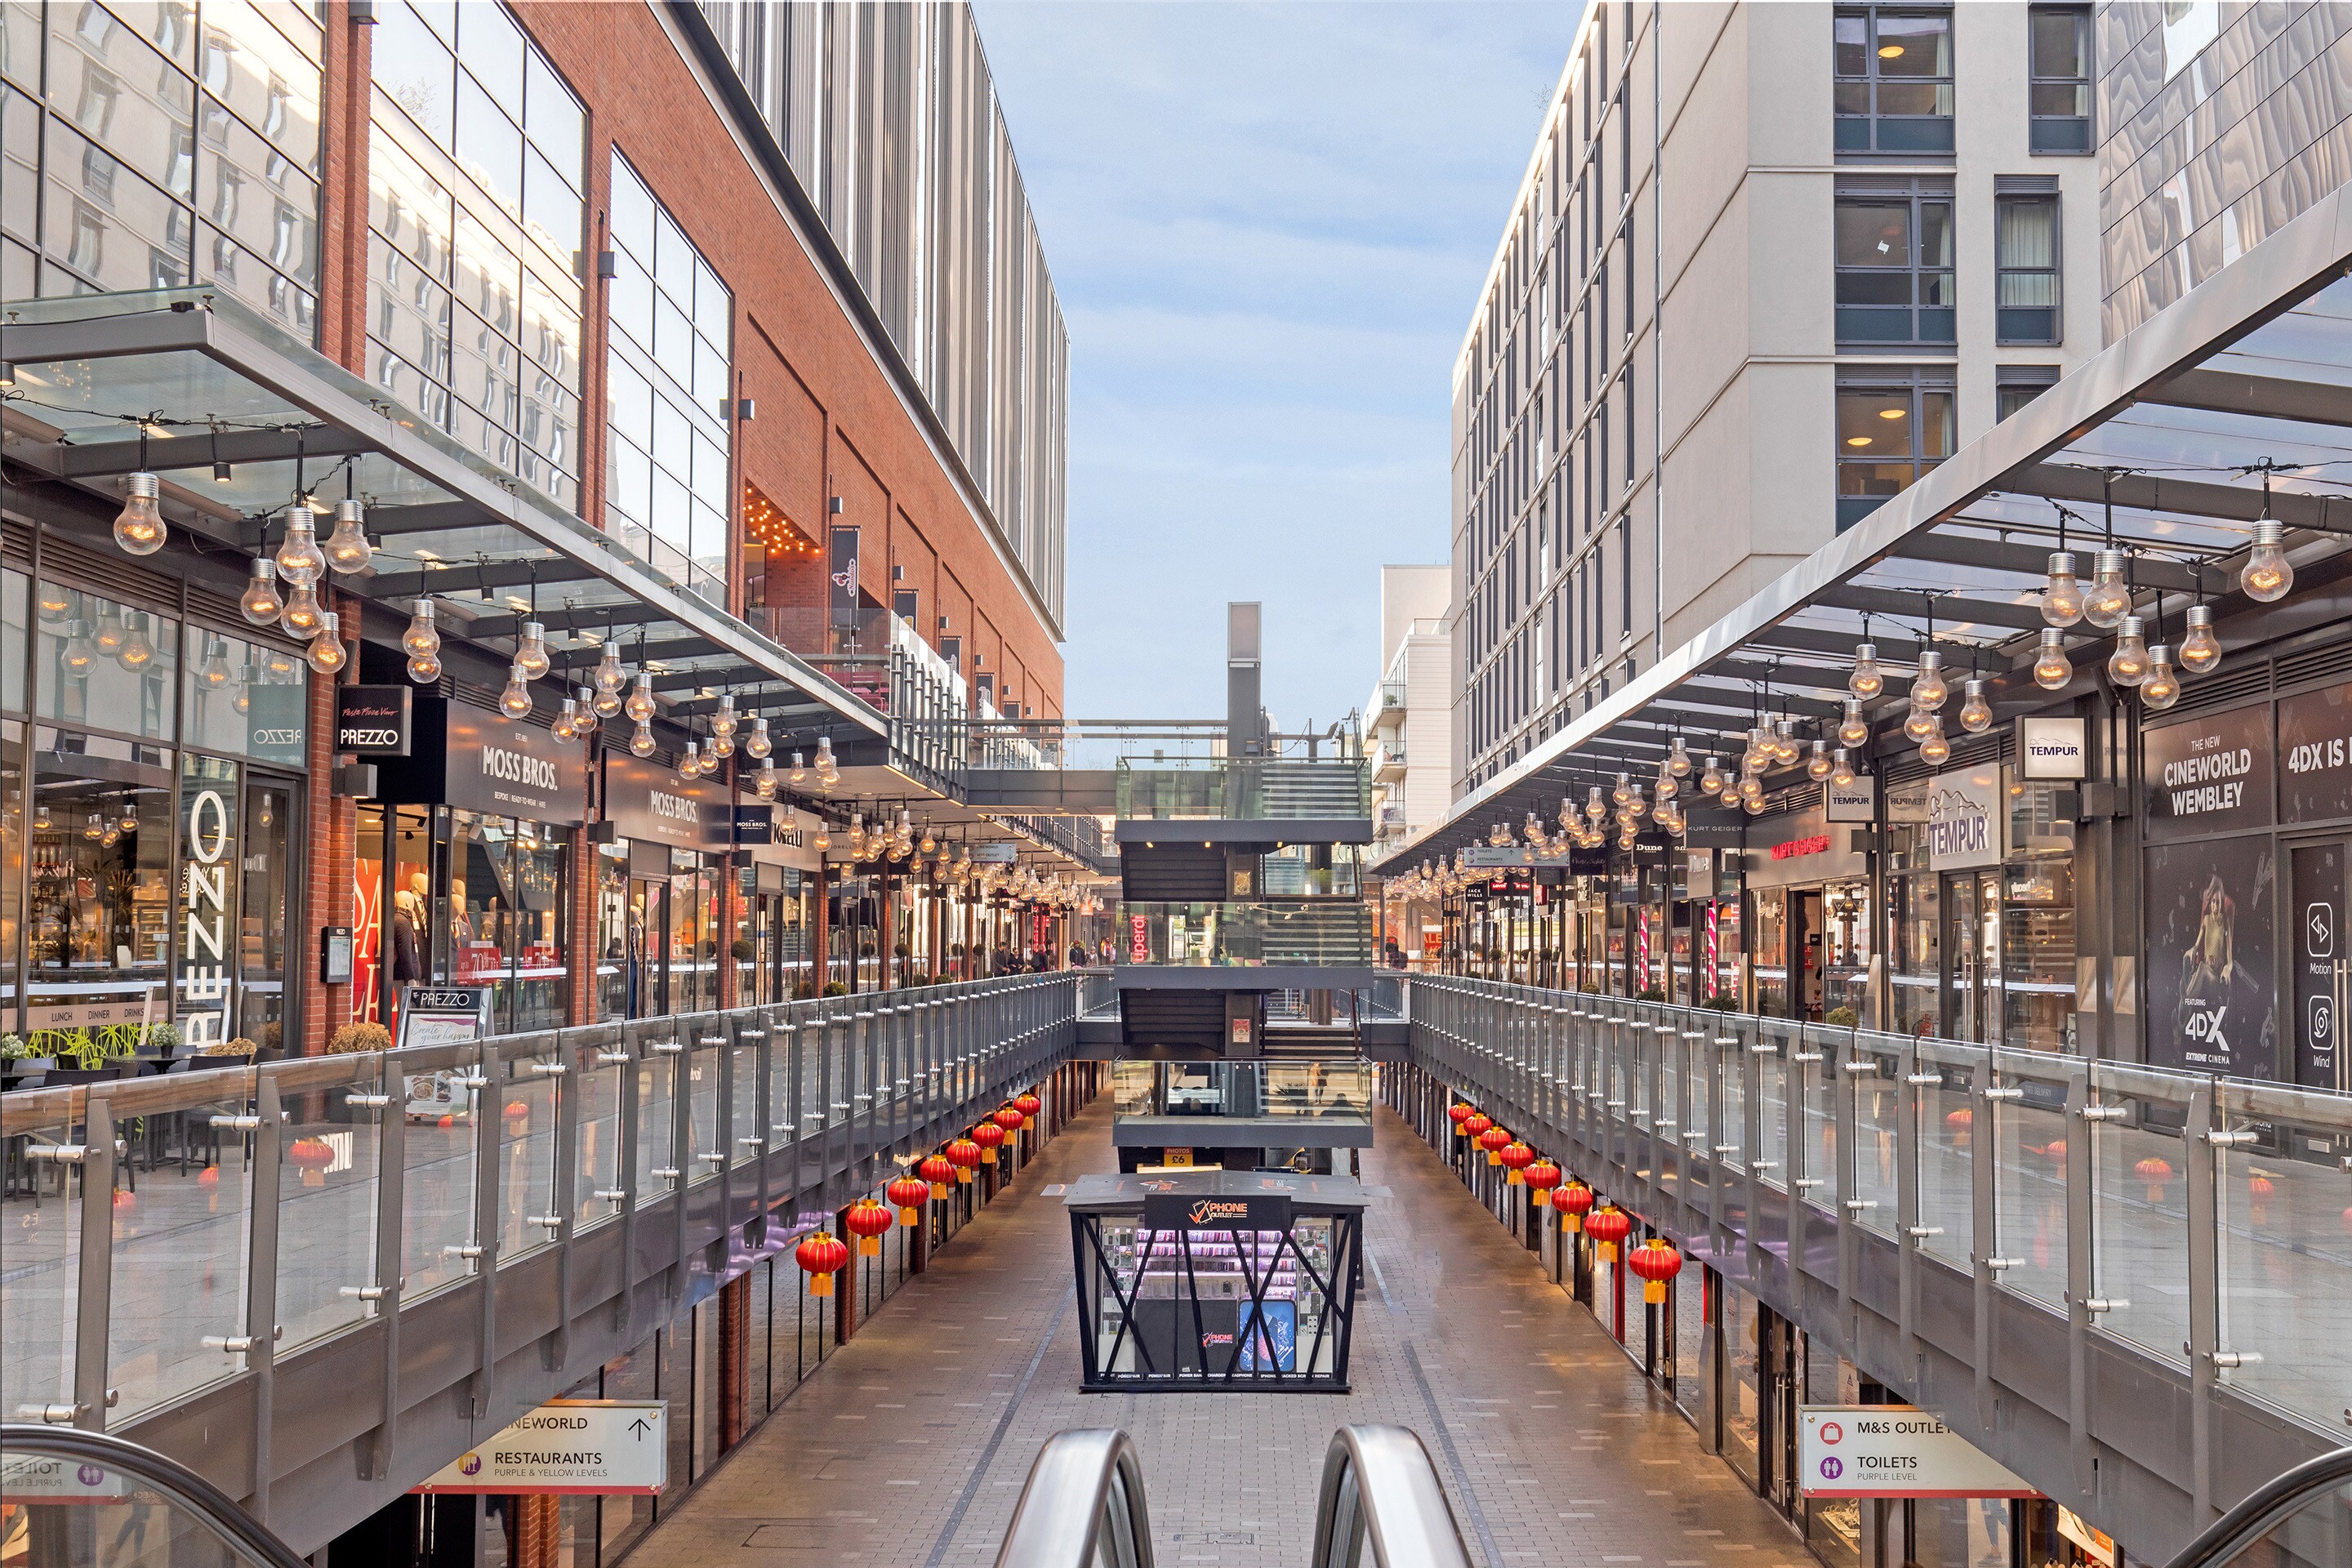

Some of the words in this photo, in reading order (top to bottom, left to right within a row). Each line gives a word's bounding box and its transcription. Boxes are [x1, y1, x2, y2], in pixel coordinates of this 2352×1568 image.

[341, 707, 362, 718] Pasta
[361, 706, 381, 717] Pizza
[380, 706, 399, 716] Vino
[340, 728, 399, 746] PREZZO
[2191, 738, 2204, 752] THE
[2204, 735, 2221, 750] NEW
[2029, 746, 2079, 756] TEMPUR
[2288, 742, 2323, 773] 4DX
[2327, 737, 2345, 768] IS
[482, 744, 521, 782] MOSS
[522, 755, 559, 791] BROS.
[2164, 747, 2252, 788] CINEWORLD
[494, 791, 509, 802] BESPOKE
[1832, 796, 1870, 805] TEMPUR
[2172, 781, 2244, 817] WEMBLEY
[651, 790, 675, 817] MOSS
[675, 796, 698, 824] BROS.
[1930, 814, 1988, 856] TEMPUR
[1771, 840, 1793, 860] KURT
[186, 789, 227, 1049] REZZO
[2310, 962, 2332, 976] Motion
[420, 992, 470, 1006] PREZZO
[2185, 998, 2207, 1007] FEATURING
[51, 1011, 73, 1022] LUNCH
[87, 1009, 110, 1020] DINNER
[124, 1007, 145, 1018] DRINKS
[411, 1022, 443, 1036] Create
[2185, 1005, 2230, 1052] 4DX
[421, 1032, 442, 1045] your
[2185, 1052, 2207, 1062] EXTREME
[2207, 1054, 2230, 1066] CINEMA
[2313, 1054, 2331, 1068] Wind
[1172, 1155, 1185, 1165] £6
[1209, 1202, 1248, 1213] PHONE
[506, 1417, 588, 1430] NEWORLD
[1857, 1421, 1891, 1434] M&S
[495, 1452, 603, 1465] RESTAURANTS
[1857, 1455, 1918, 1469] TOILETS
[494, 1468, 527, 1477] PURPLE
[528, 1468, 536, 1477] &
[536, 1468, 575, 1477] YELLOW
[576, 1468, 608, 1478] LEVELS
[1857, 1472, 1889, 1481] PURPLE
[1891, 1472, 1918, 1481] LEVEL
